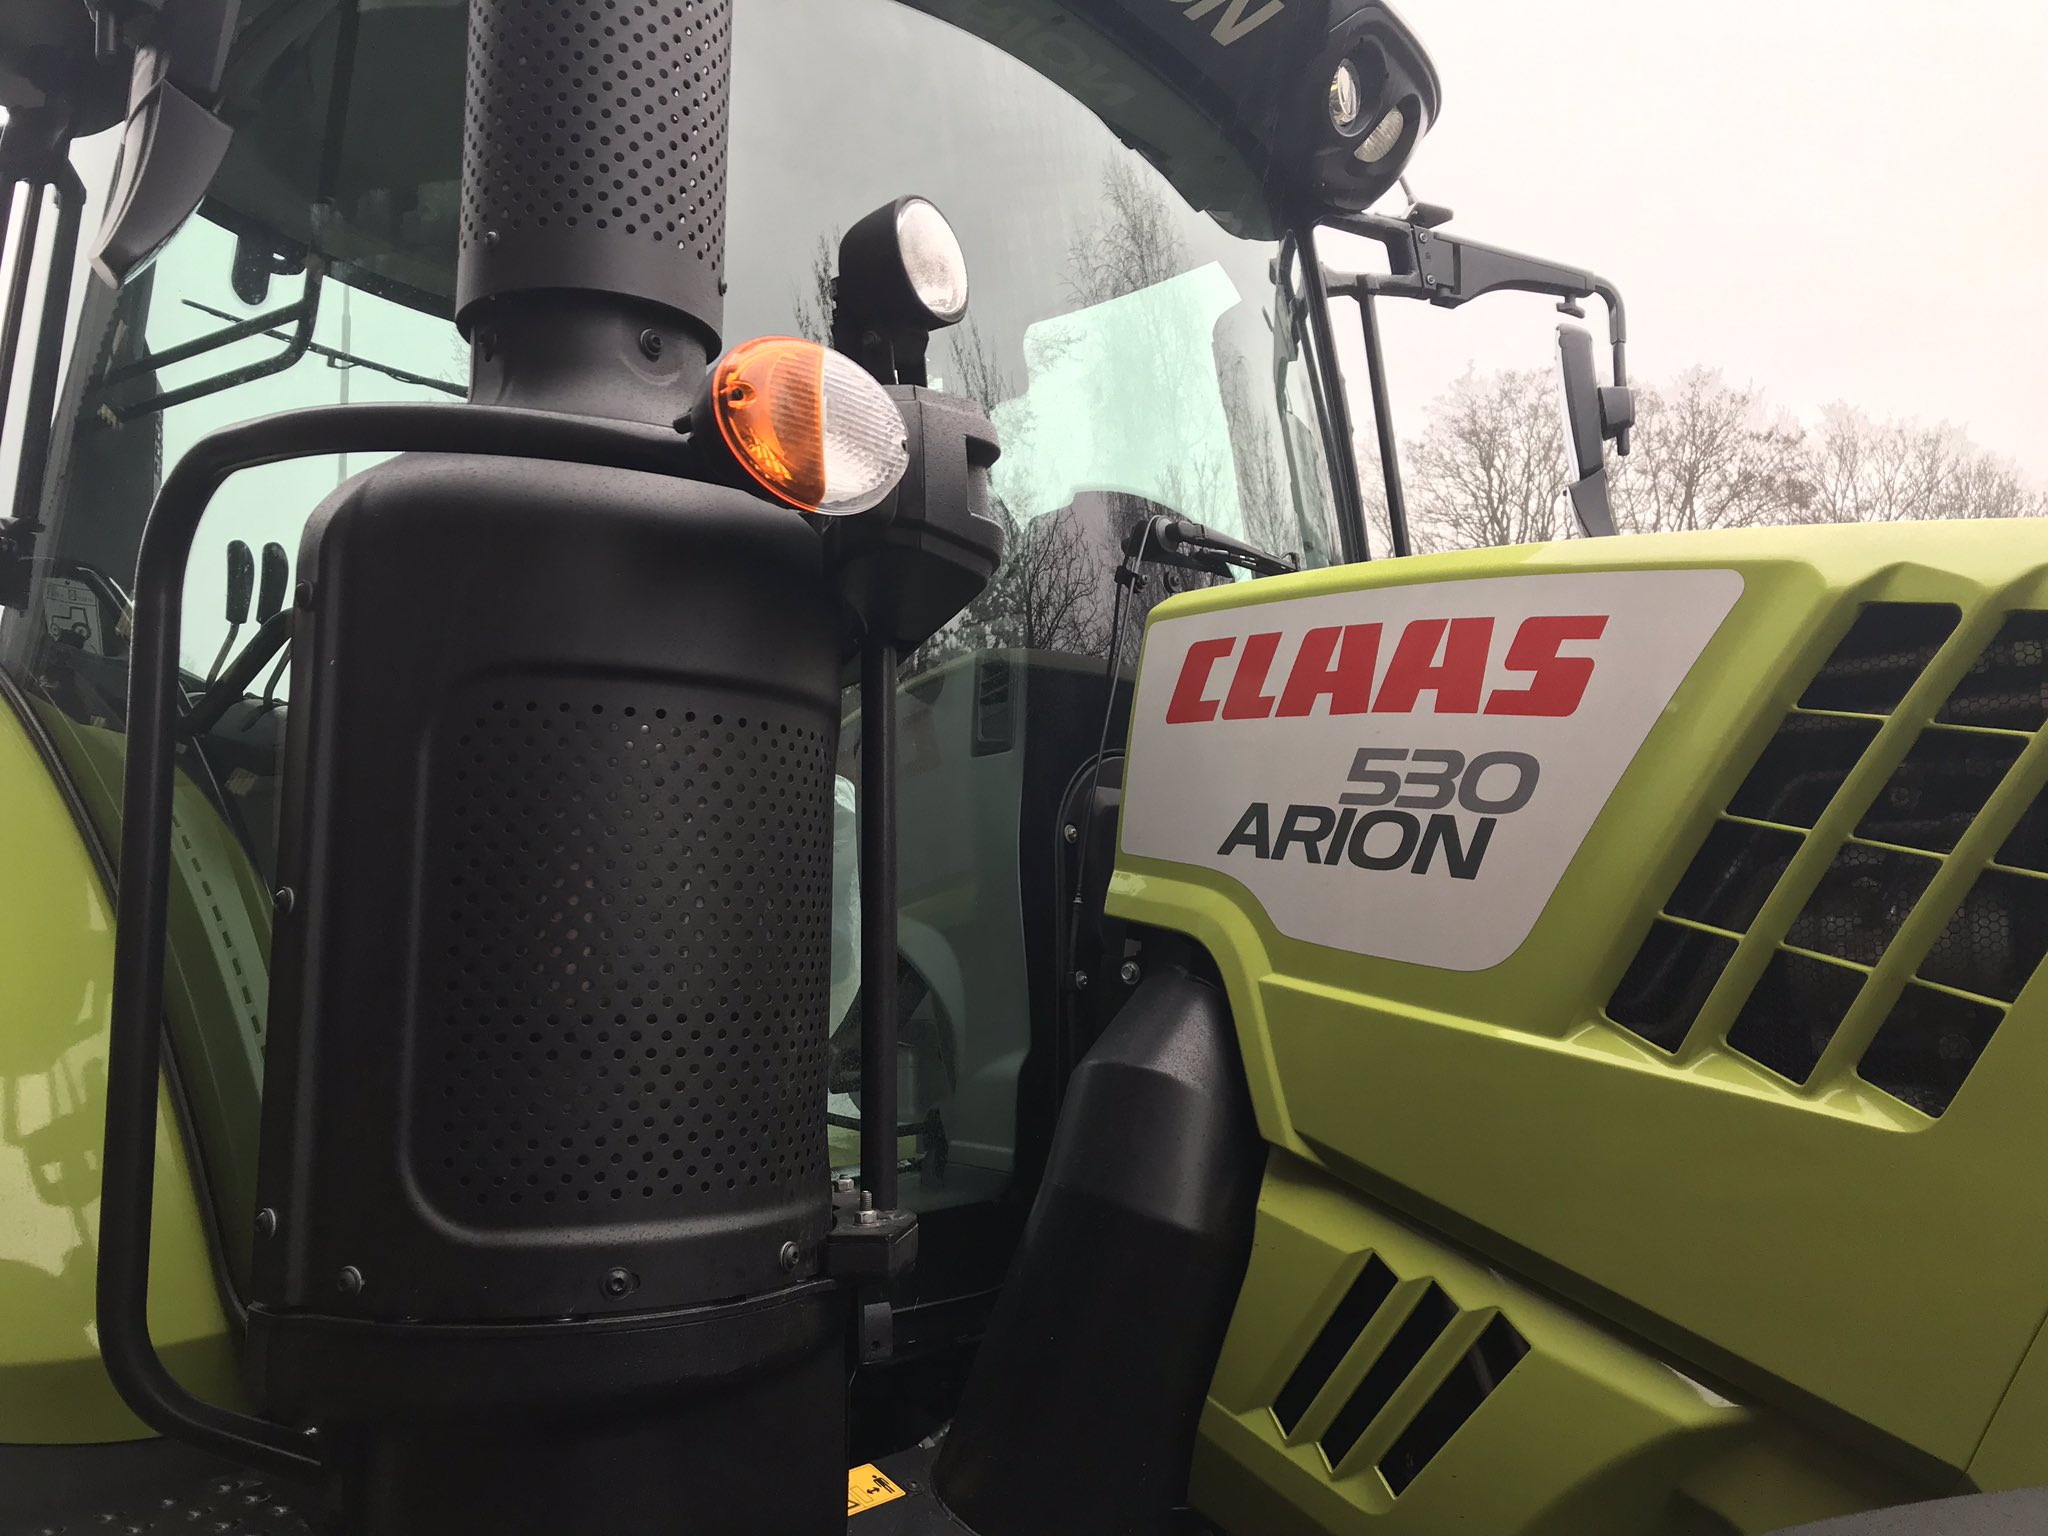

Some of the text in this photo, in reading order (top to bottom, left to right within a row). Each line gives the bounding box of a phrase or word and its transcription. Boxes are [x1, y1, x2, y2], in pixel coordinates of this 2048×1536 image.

[1166, 615, 1610, 724] CLAAS
[1338, 747, 1541, 815] 530
[1217, 802, 1498, 881] ARION
